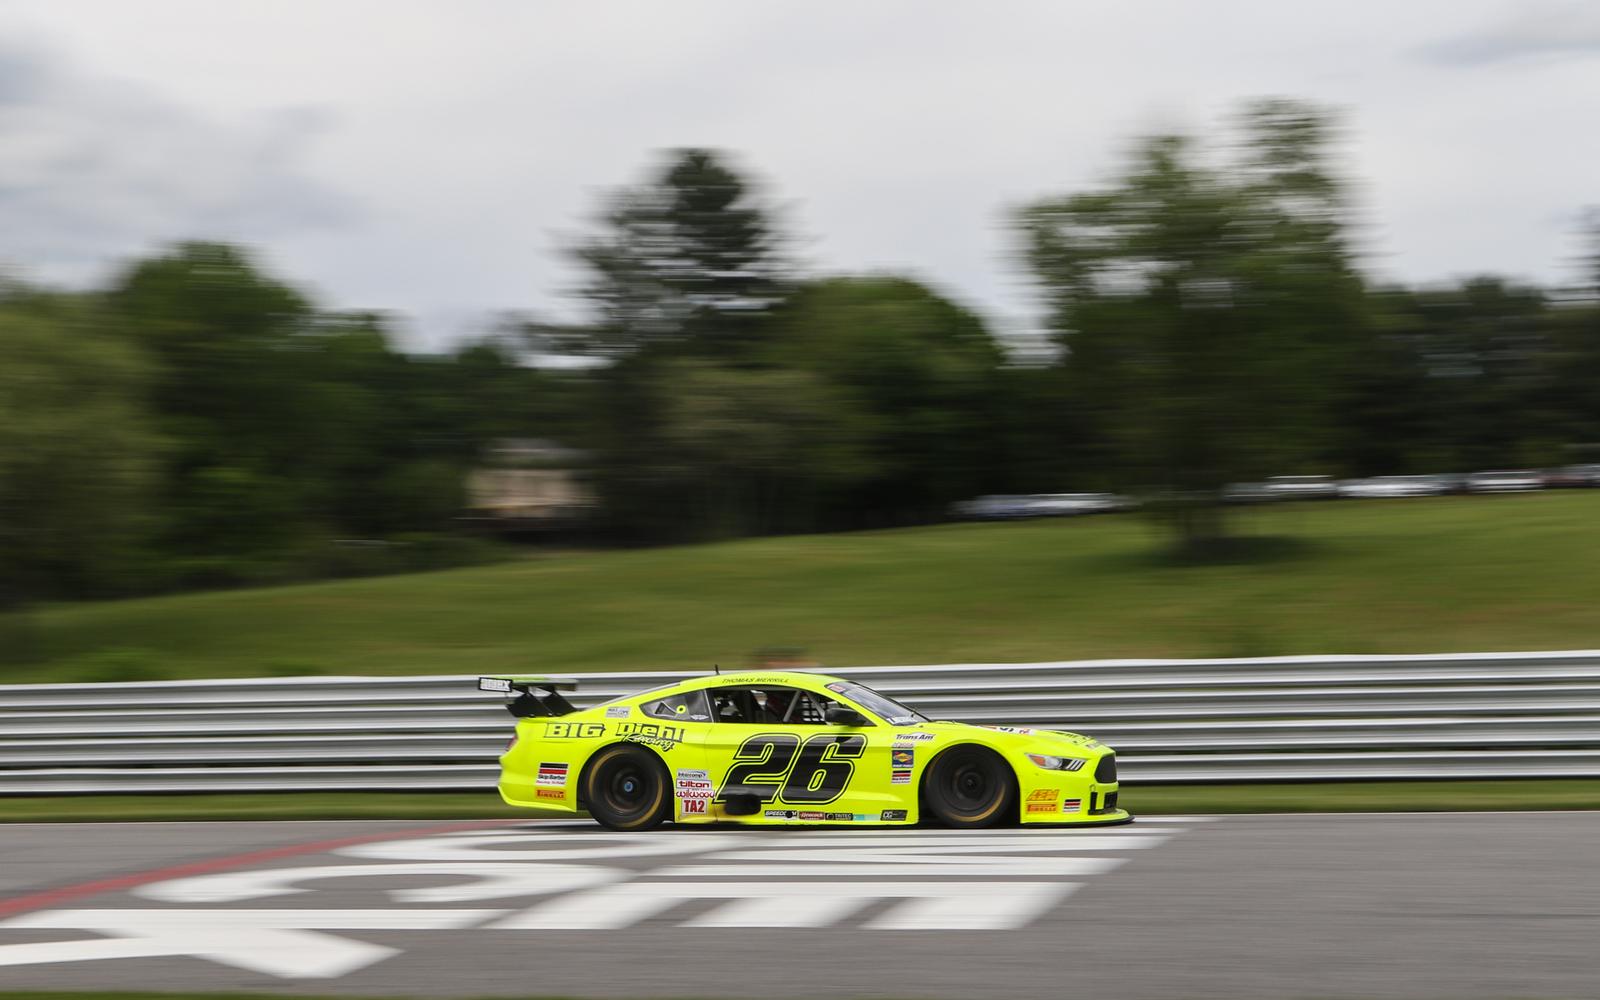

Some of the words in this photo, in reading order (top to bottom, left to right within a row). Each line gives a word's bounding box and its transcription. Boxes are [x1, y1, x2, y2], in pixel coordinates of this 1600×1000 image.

[544, 722, 606, 738] BIG
[616, 722, 685, 743] Diehl
[712, 732, 868, 805] 26
[678, 780, 710, 788] tilton
[684, 799, 705, 813] TA2
